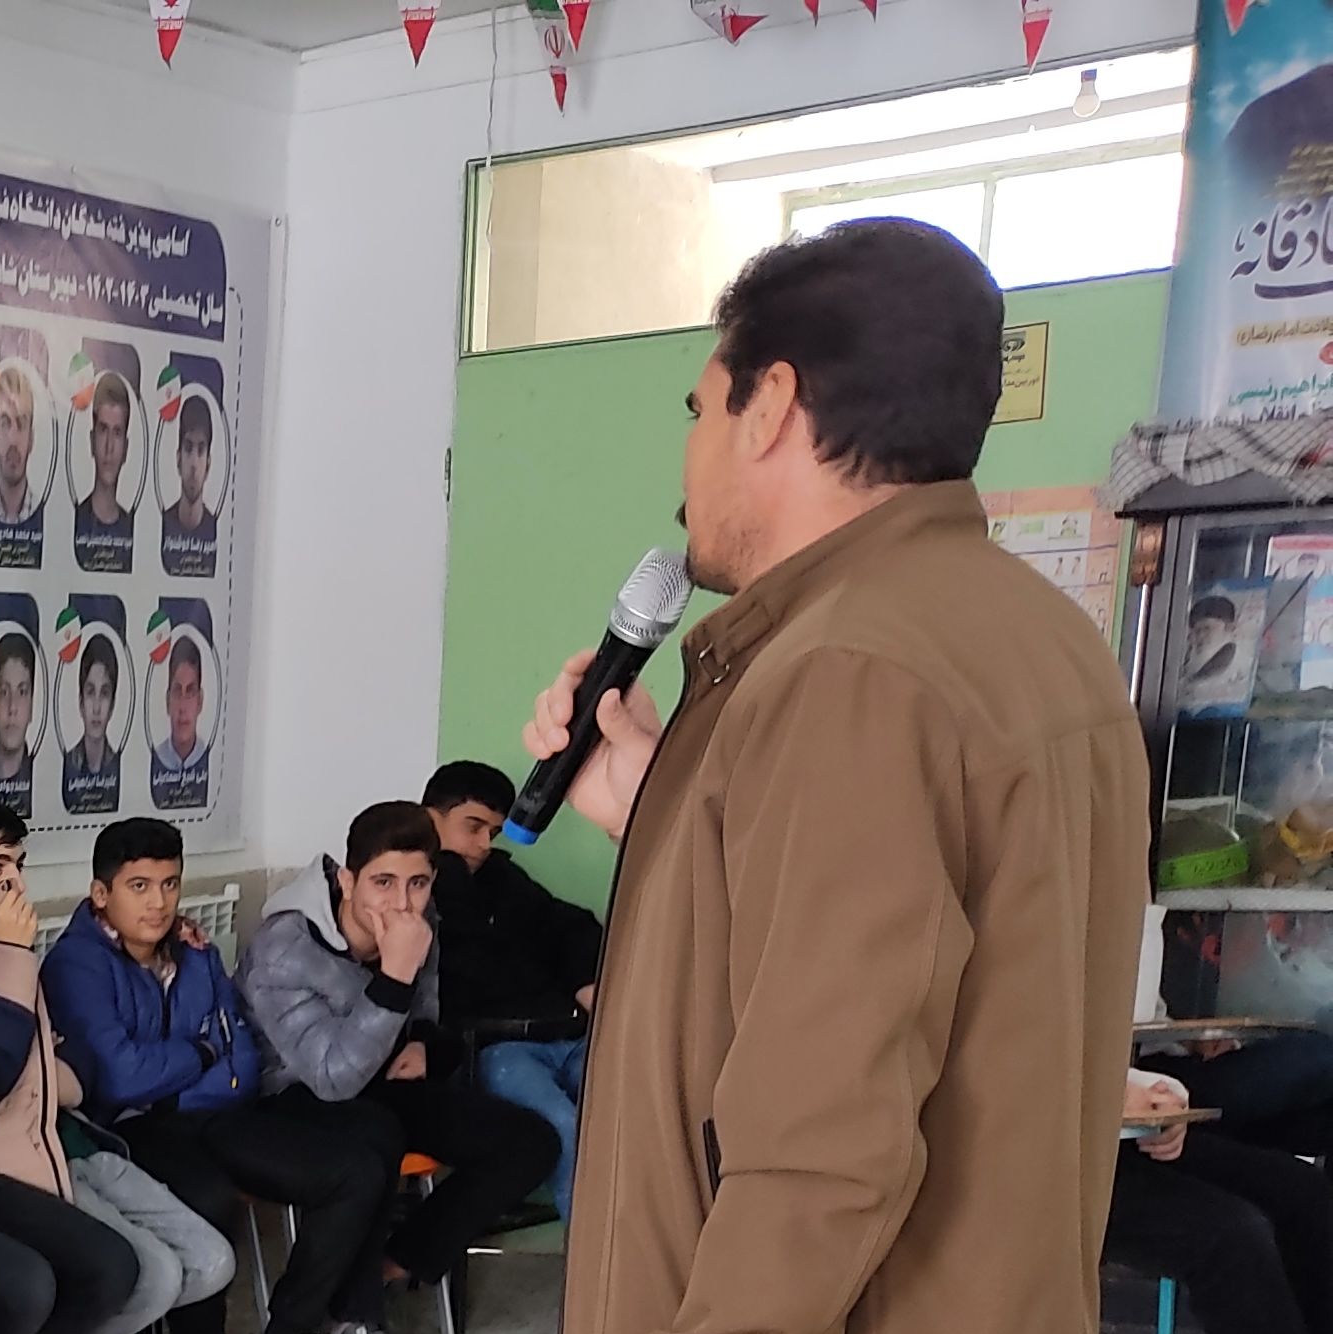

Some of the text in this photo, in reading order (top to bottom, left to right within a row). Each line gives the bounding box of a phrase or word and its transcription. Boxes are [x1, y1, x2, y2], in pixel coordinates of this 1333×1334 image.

[9, 189, 62, 231] دانشگاه
[62, 201, 105, 240] شدگان
[152, 224, 191, 259] اسامی
[1229, 198, 1333, 281] ادقانه
[148, 285, 201, 321] تحصیلی
[201, 291, 224, 329] سال
[1234, 378, 1278, 406] رئیسی
